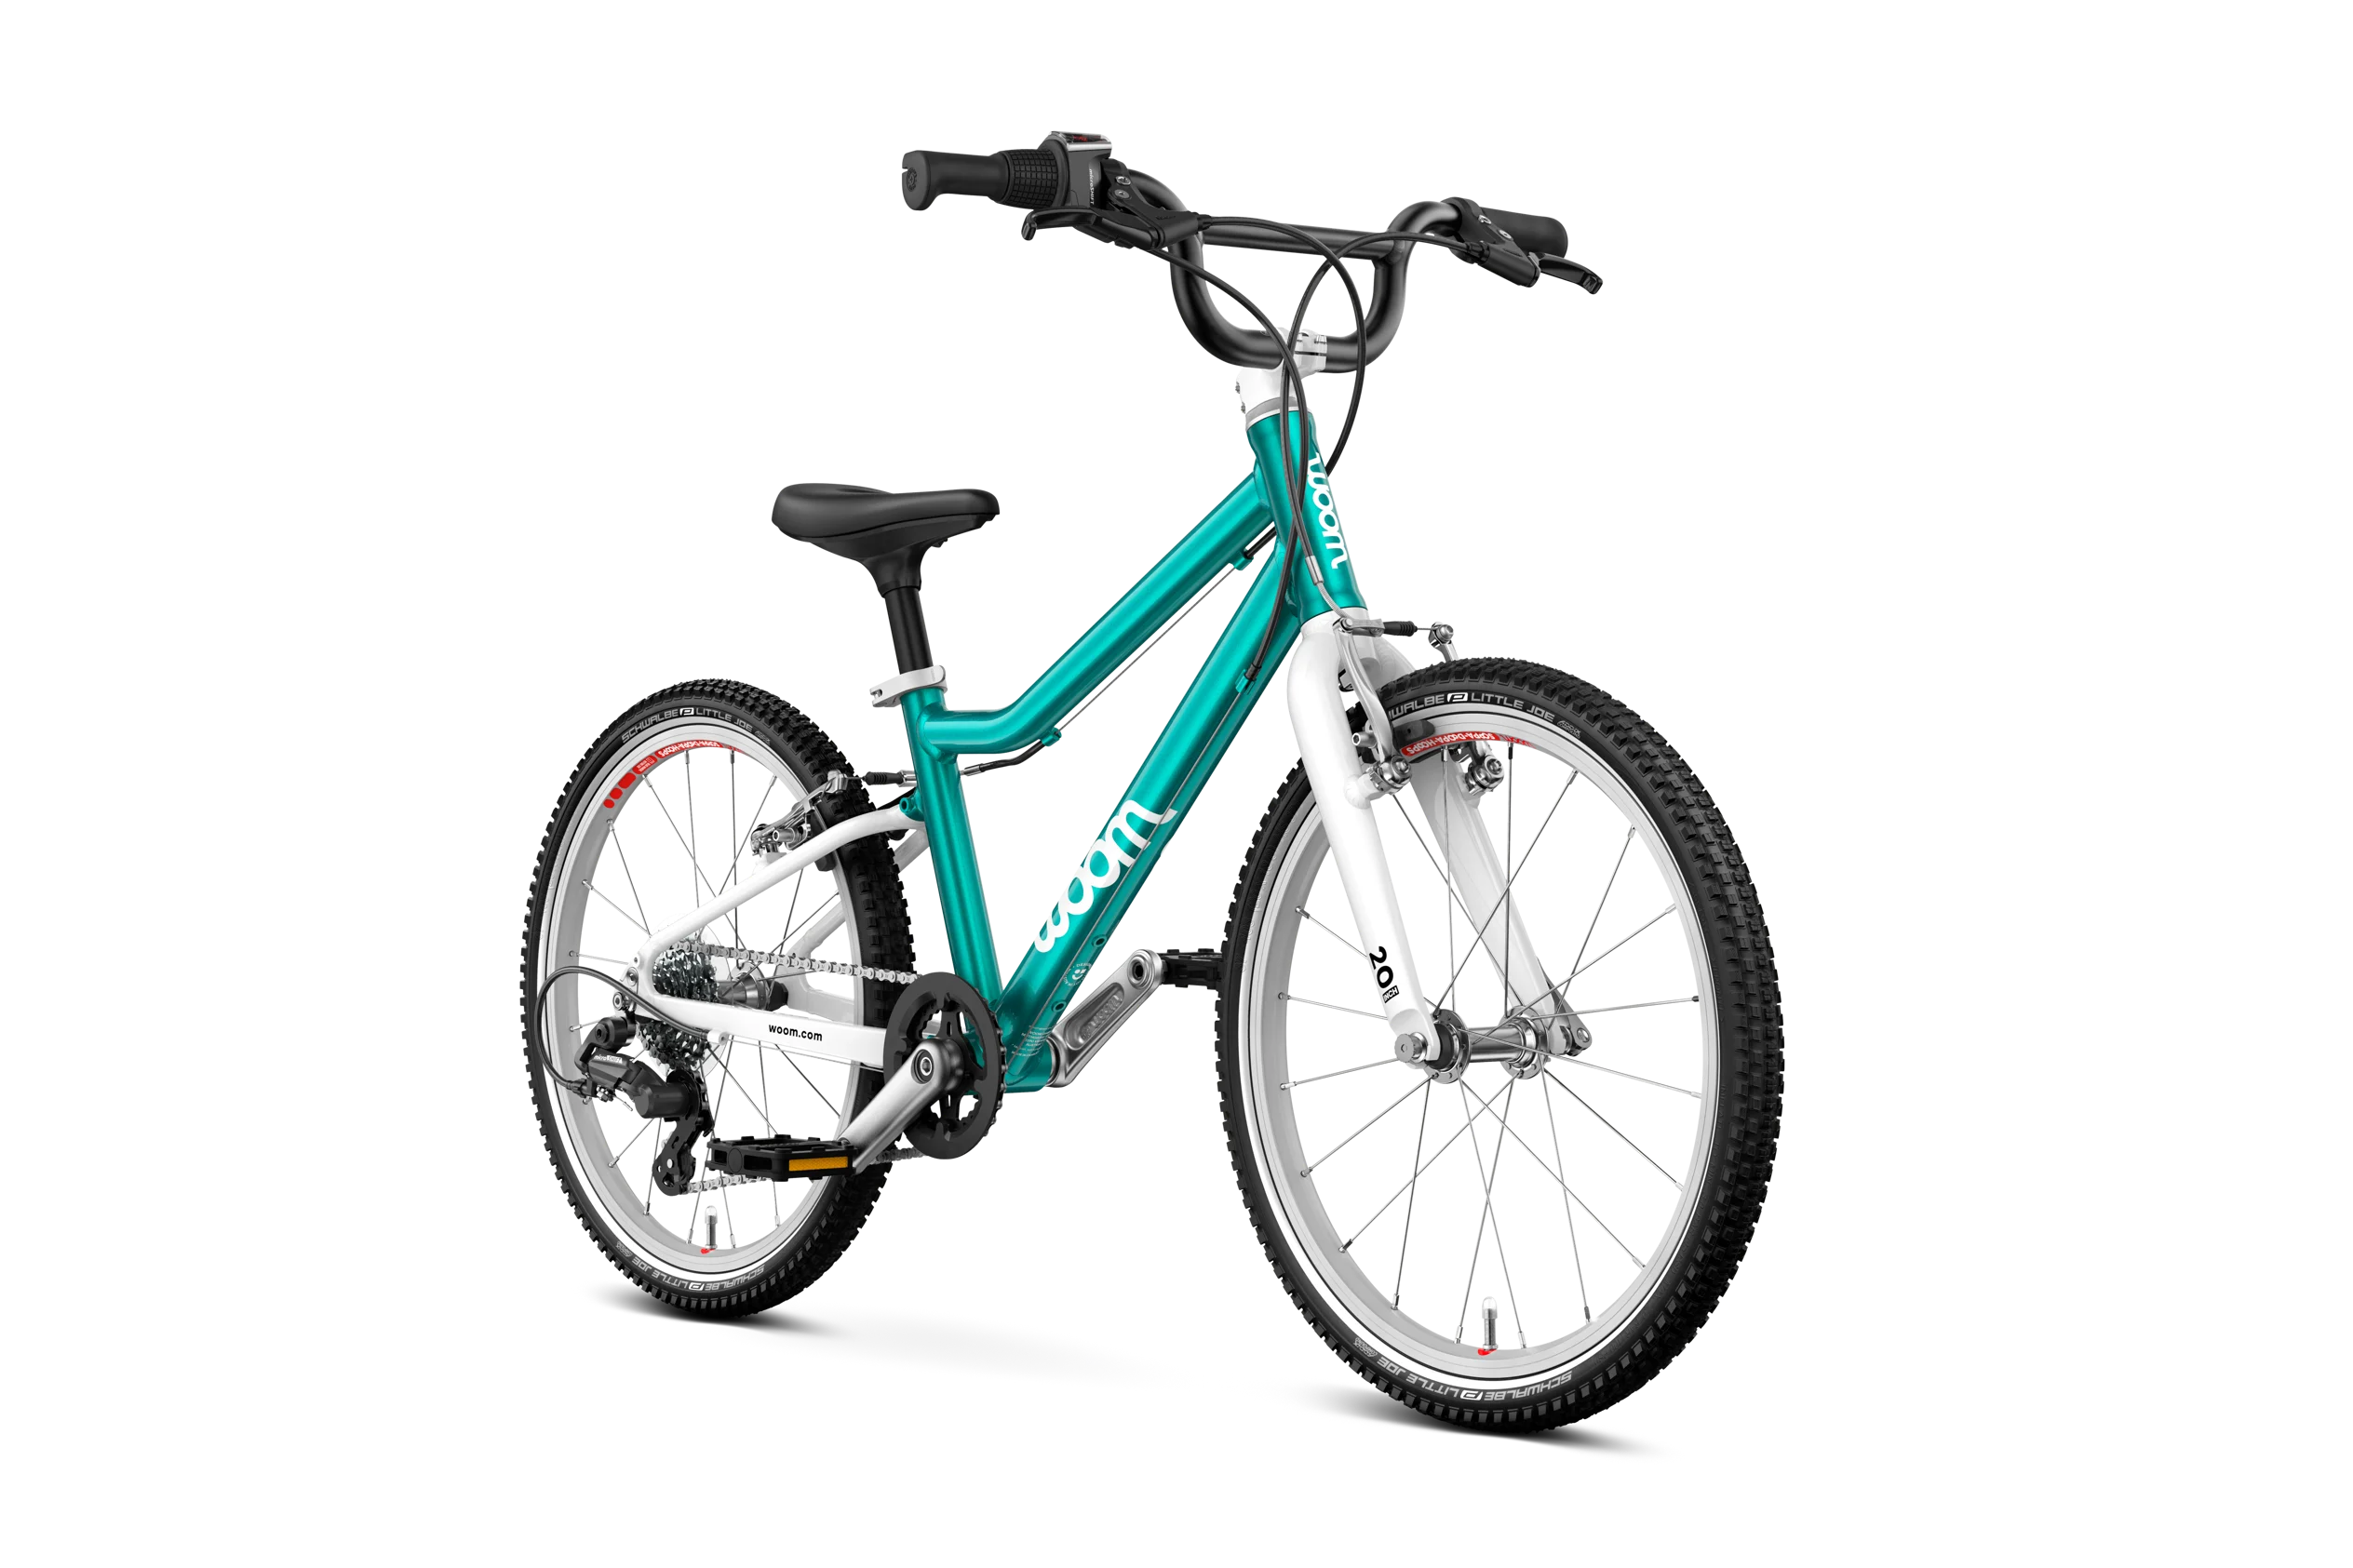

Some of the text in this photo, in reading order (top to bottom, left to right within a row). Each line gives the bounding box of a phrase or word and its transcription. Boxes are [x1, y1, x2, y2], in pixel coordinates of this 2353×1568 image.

[1307, 452, 1348, 569] woom
[621, 707, 753, 744] SCHWALBE LITTLE JOE
[1471, 692, 1524, 710] LITTLE
[1526, 705, 1555, 723] JOE
[1034, 799, 1177, 953] woom
[1369, 945, 1393, 988] 20
[768, 1024, 823, 1041] woom.com
[632, 1256, 765, 1291] SCHWALBE LITTLE JOE
[1377, 1356, 1573, 1401] SCHWALBE LITTLE JOE
